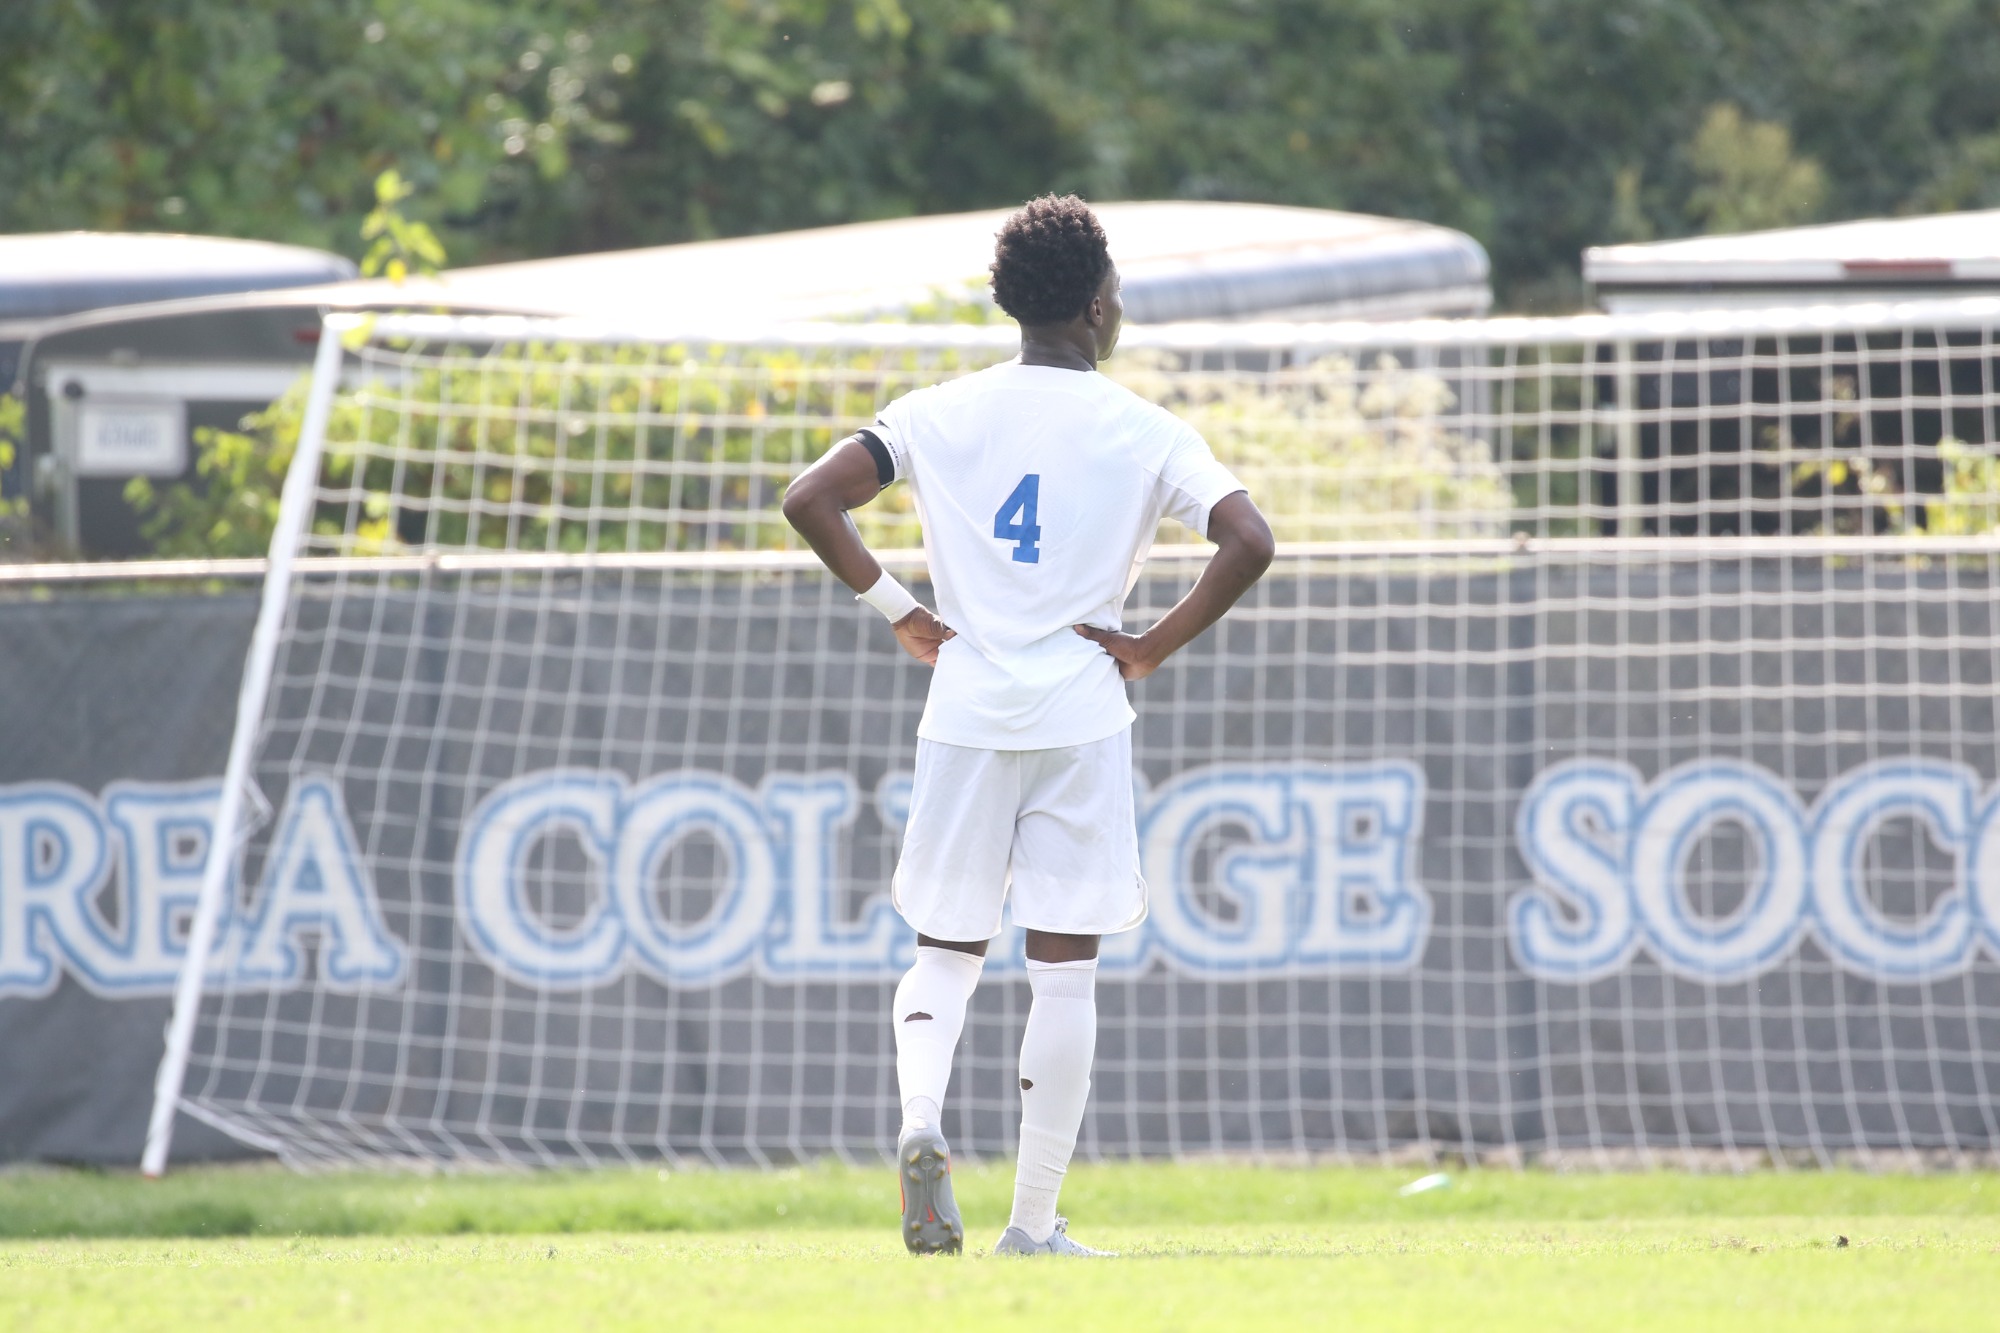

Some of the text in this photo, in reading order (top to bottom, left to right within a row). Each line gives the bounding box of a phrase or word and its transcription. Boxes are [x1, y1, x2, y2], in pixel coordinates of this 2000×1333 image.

[994, 473, 1041, 564] 4
[455, 764, 1432, 991] COLGE
[1507, 755, 2000, 985] SOC
